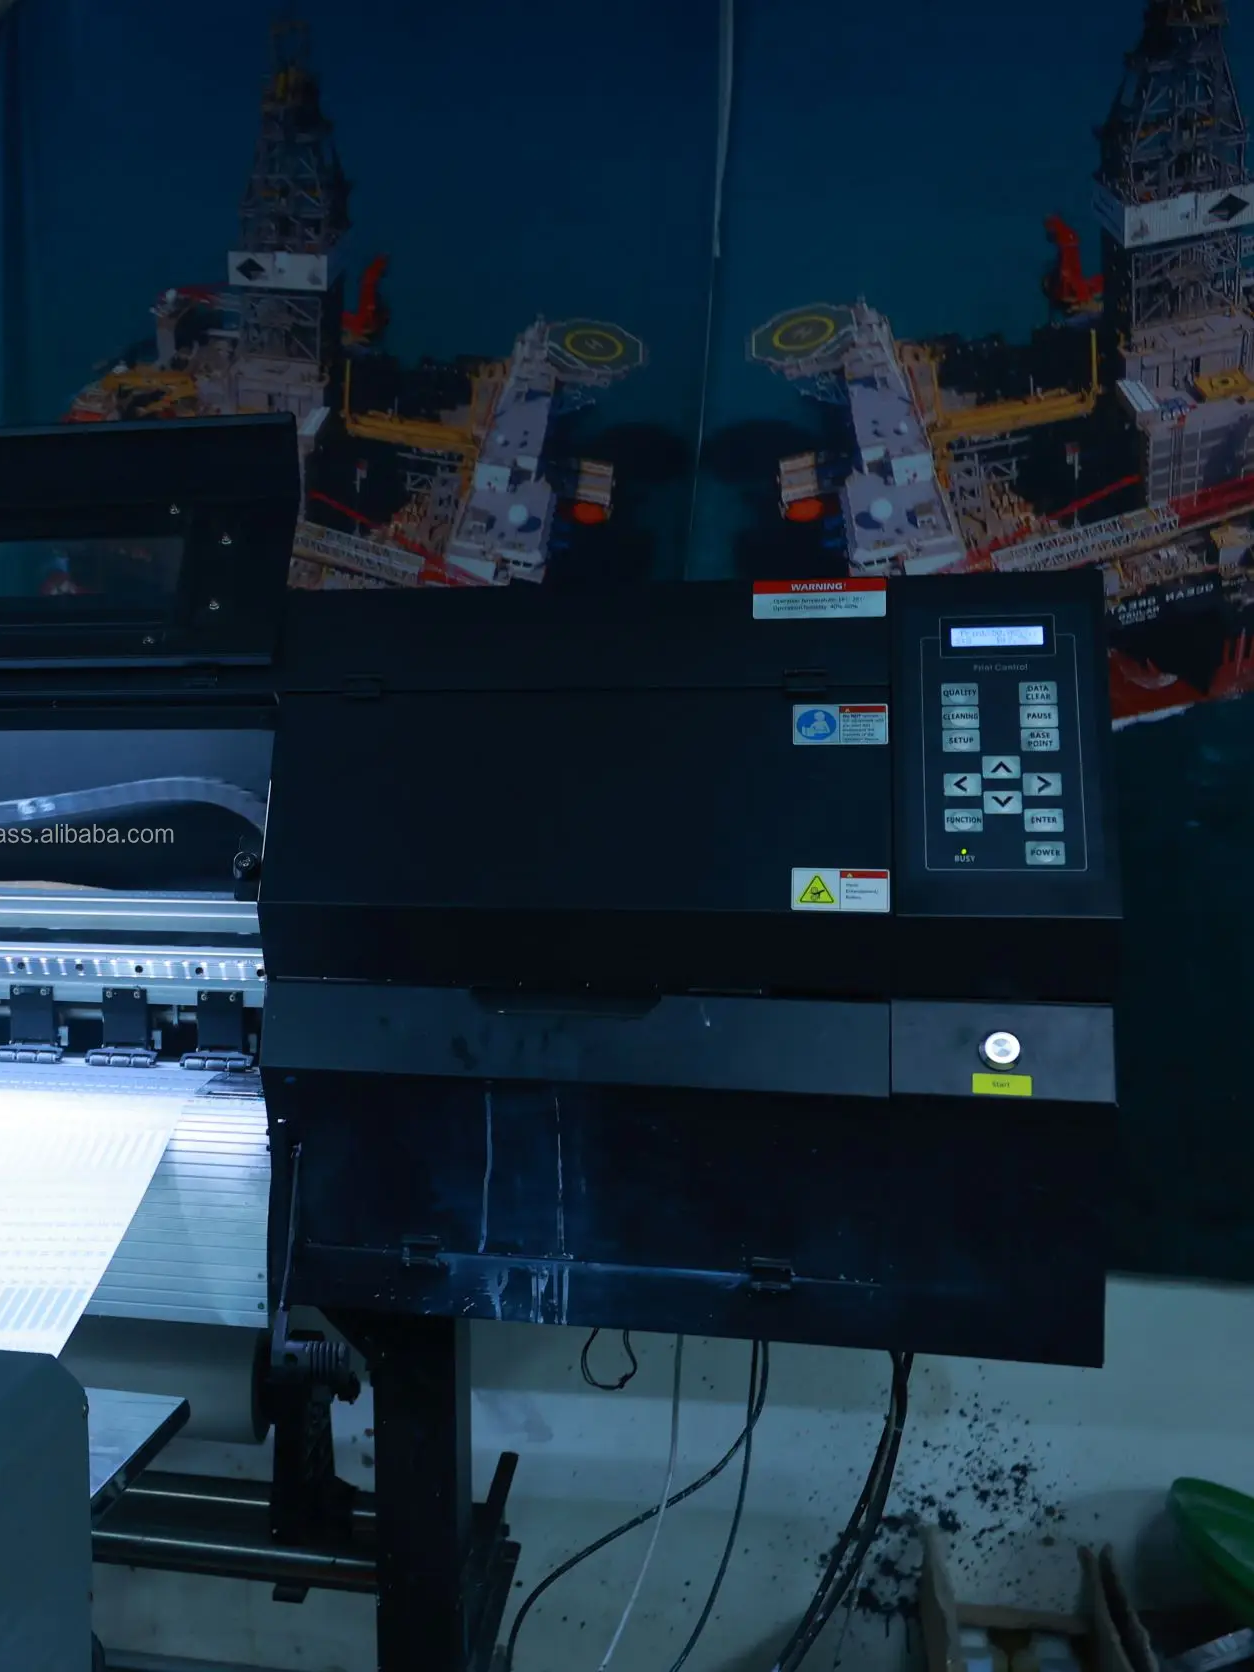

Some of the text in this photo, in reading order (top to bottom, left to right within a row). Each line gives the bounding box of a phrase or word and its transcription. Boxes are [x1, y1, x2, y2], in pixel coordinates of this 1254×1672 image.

[791, 582, 847, 592] WARNING!
[995, 663, 1028, 671] Control
[943, 689, 977, 697] QUALITY
[1027, 712, 1052, 720] PAUSE
[946, 816, 982, 824] FUNCTION
[1030, 816, 1057, 824] ENTER
[1030, 849, 1061, 857] POWER
[992, 1081, 1010, 1089] Start
